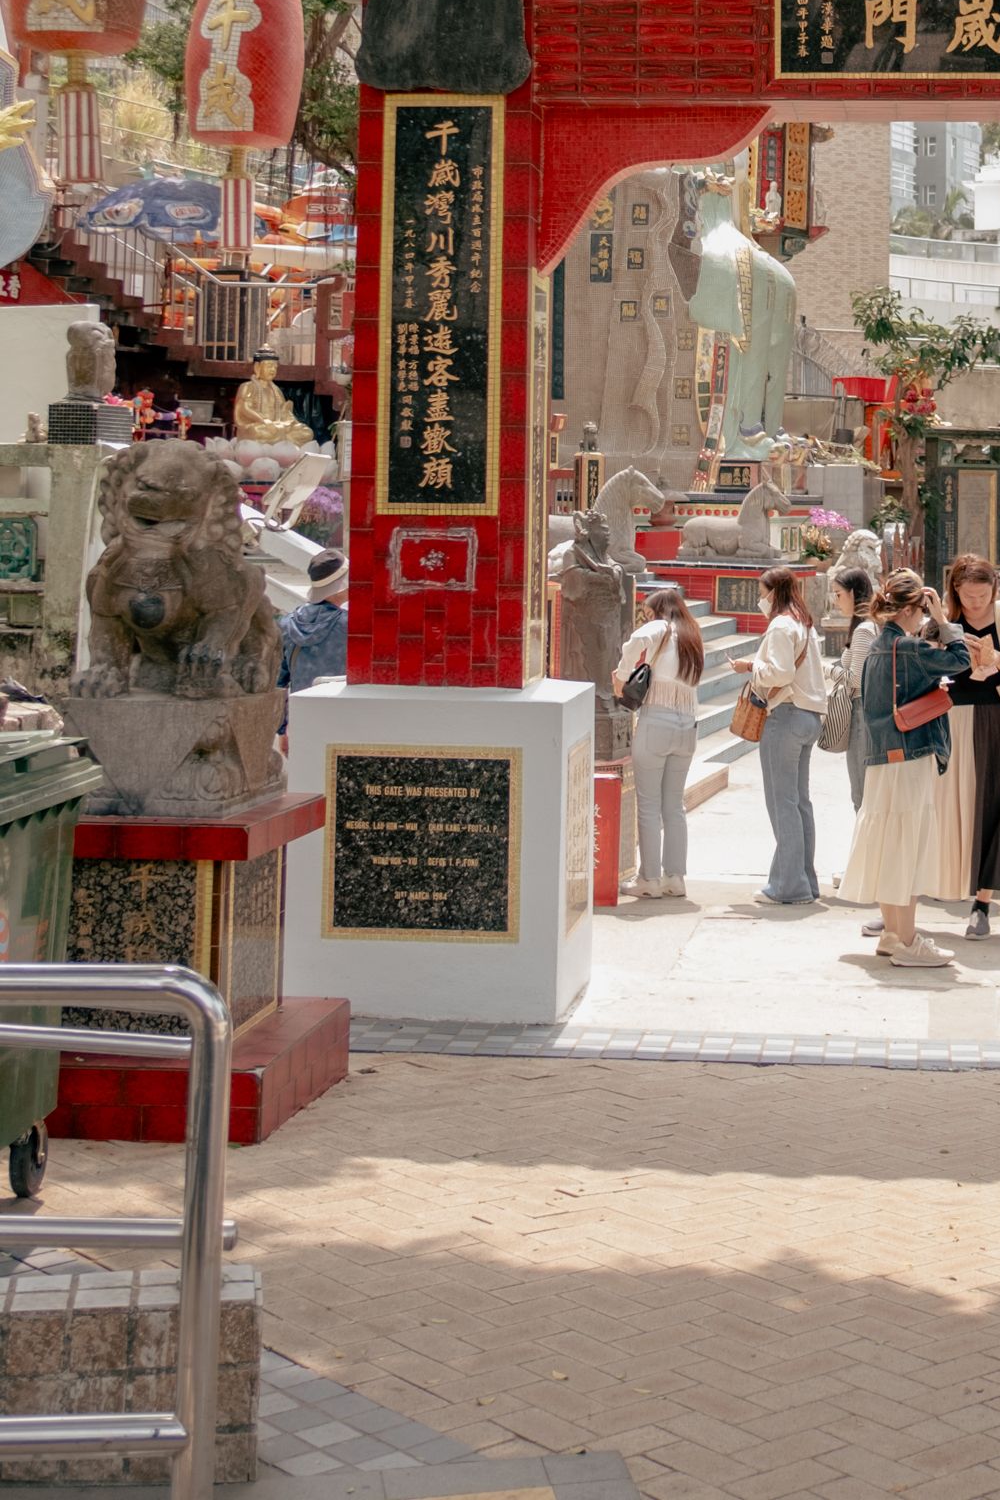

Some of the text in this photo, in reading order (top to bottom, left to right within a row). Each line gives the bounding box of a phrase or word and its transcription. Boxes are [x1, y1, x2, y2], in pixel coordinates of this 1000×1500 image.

[402, 219, 417, 309] 一九八四年甲子春
[365, 785, 481, 798] THIS GATE WAS PRESENTED BY
